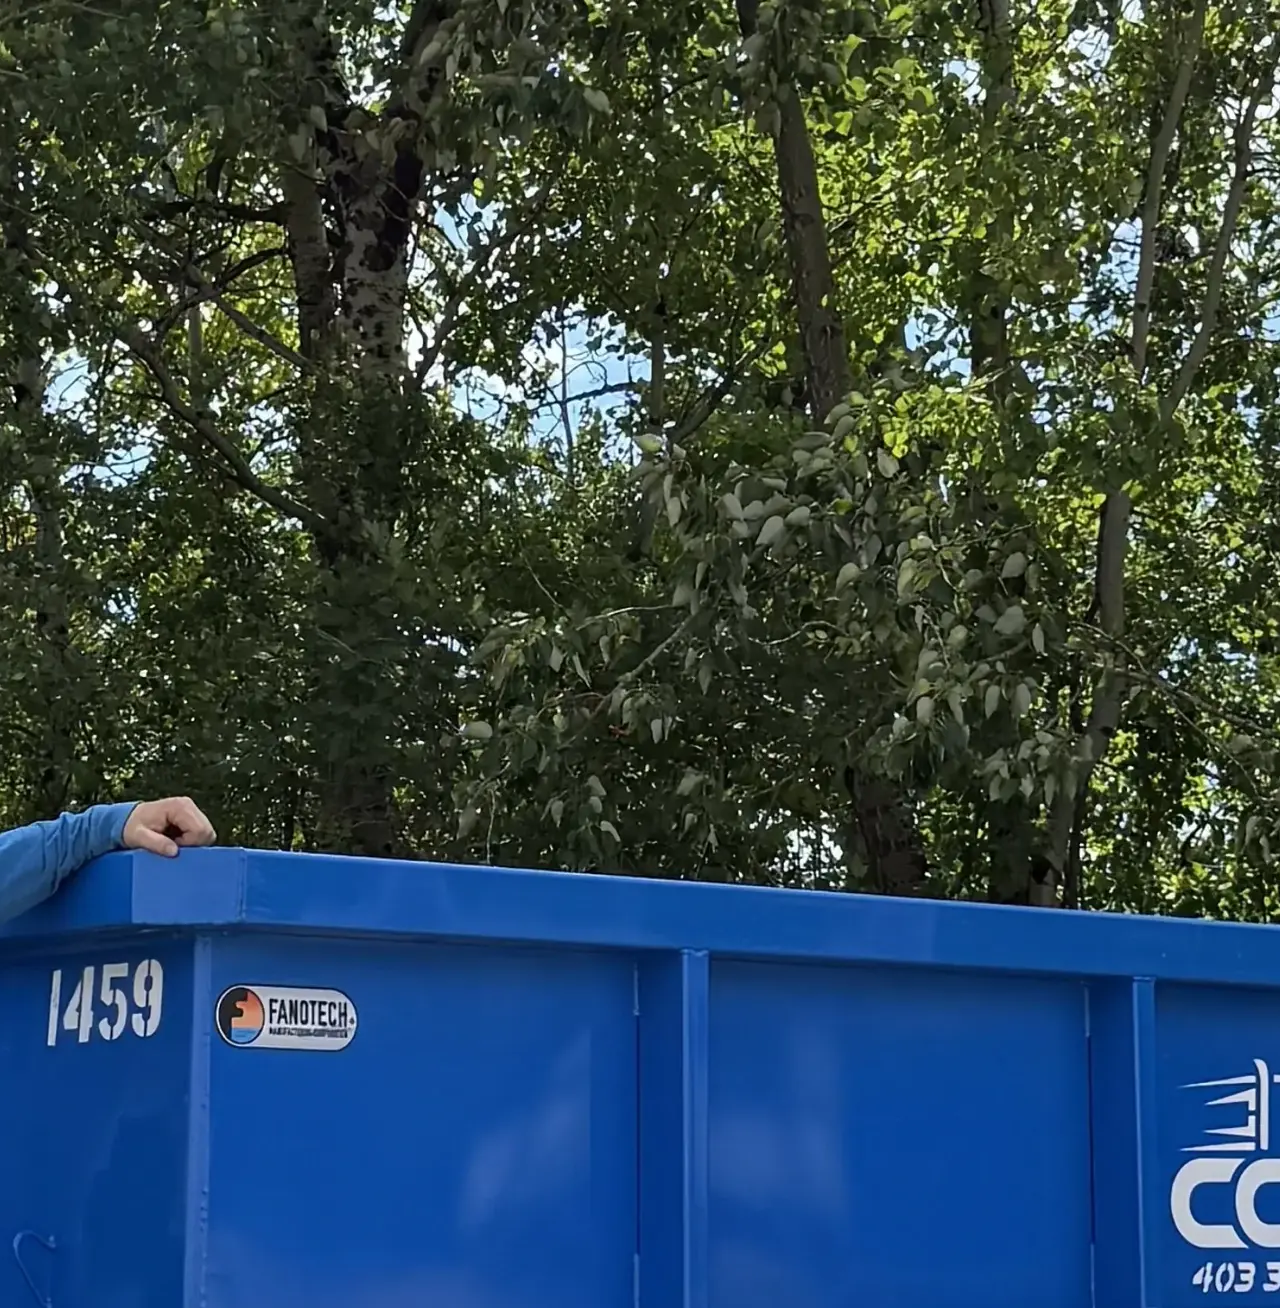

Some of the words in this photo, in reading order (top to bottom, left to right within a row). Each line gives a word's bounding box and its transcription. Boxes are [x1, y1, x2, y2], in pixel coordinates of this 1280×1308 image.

[47, 959, 163, 1046] 1459
[268, 998, 348, 1028] FANOTECH
[1192, 1261, 1256, 1293] 403
